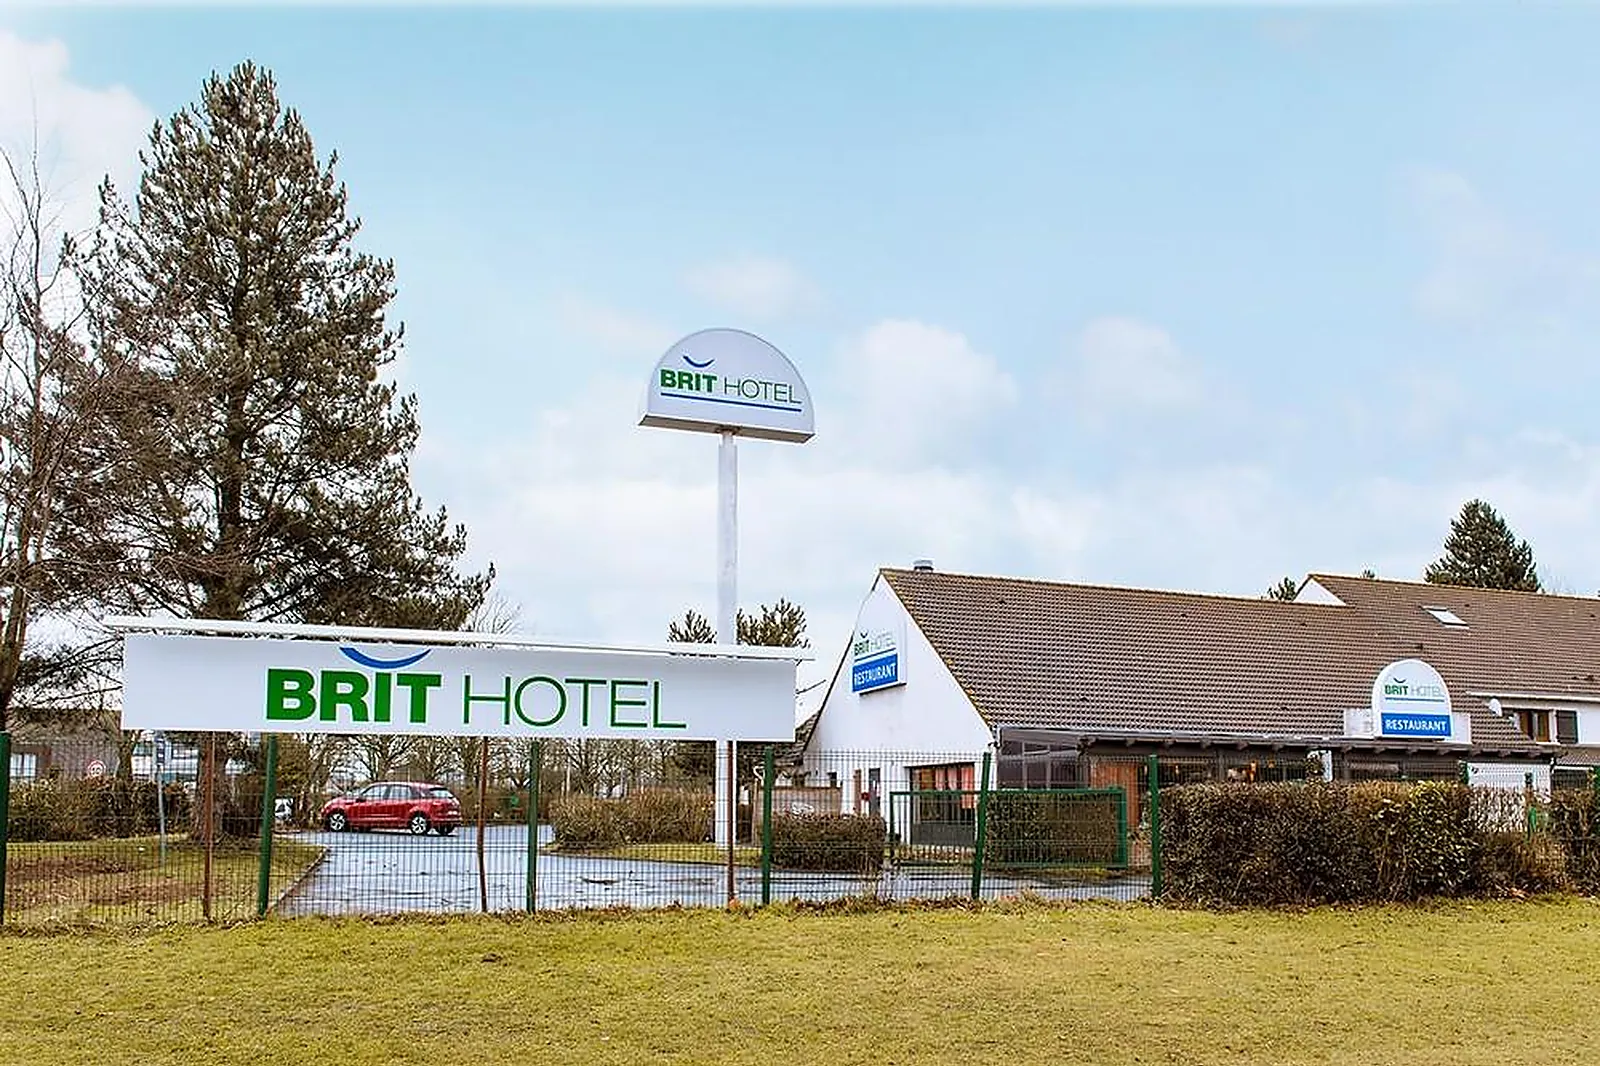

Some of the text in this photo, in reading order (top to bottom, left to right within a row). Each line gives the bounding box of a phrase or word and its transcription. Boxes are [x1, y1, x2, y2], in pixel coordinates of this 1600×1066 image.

[660, 369, 803, 404] BRIT HOTEL
[266, 668, 687, 729] BRIT HOTEL
[1384, 685, 1445, 698] BRIT HOTEL
[1384, 719, 1448, 731] RESTAURANT
